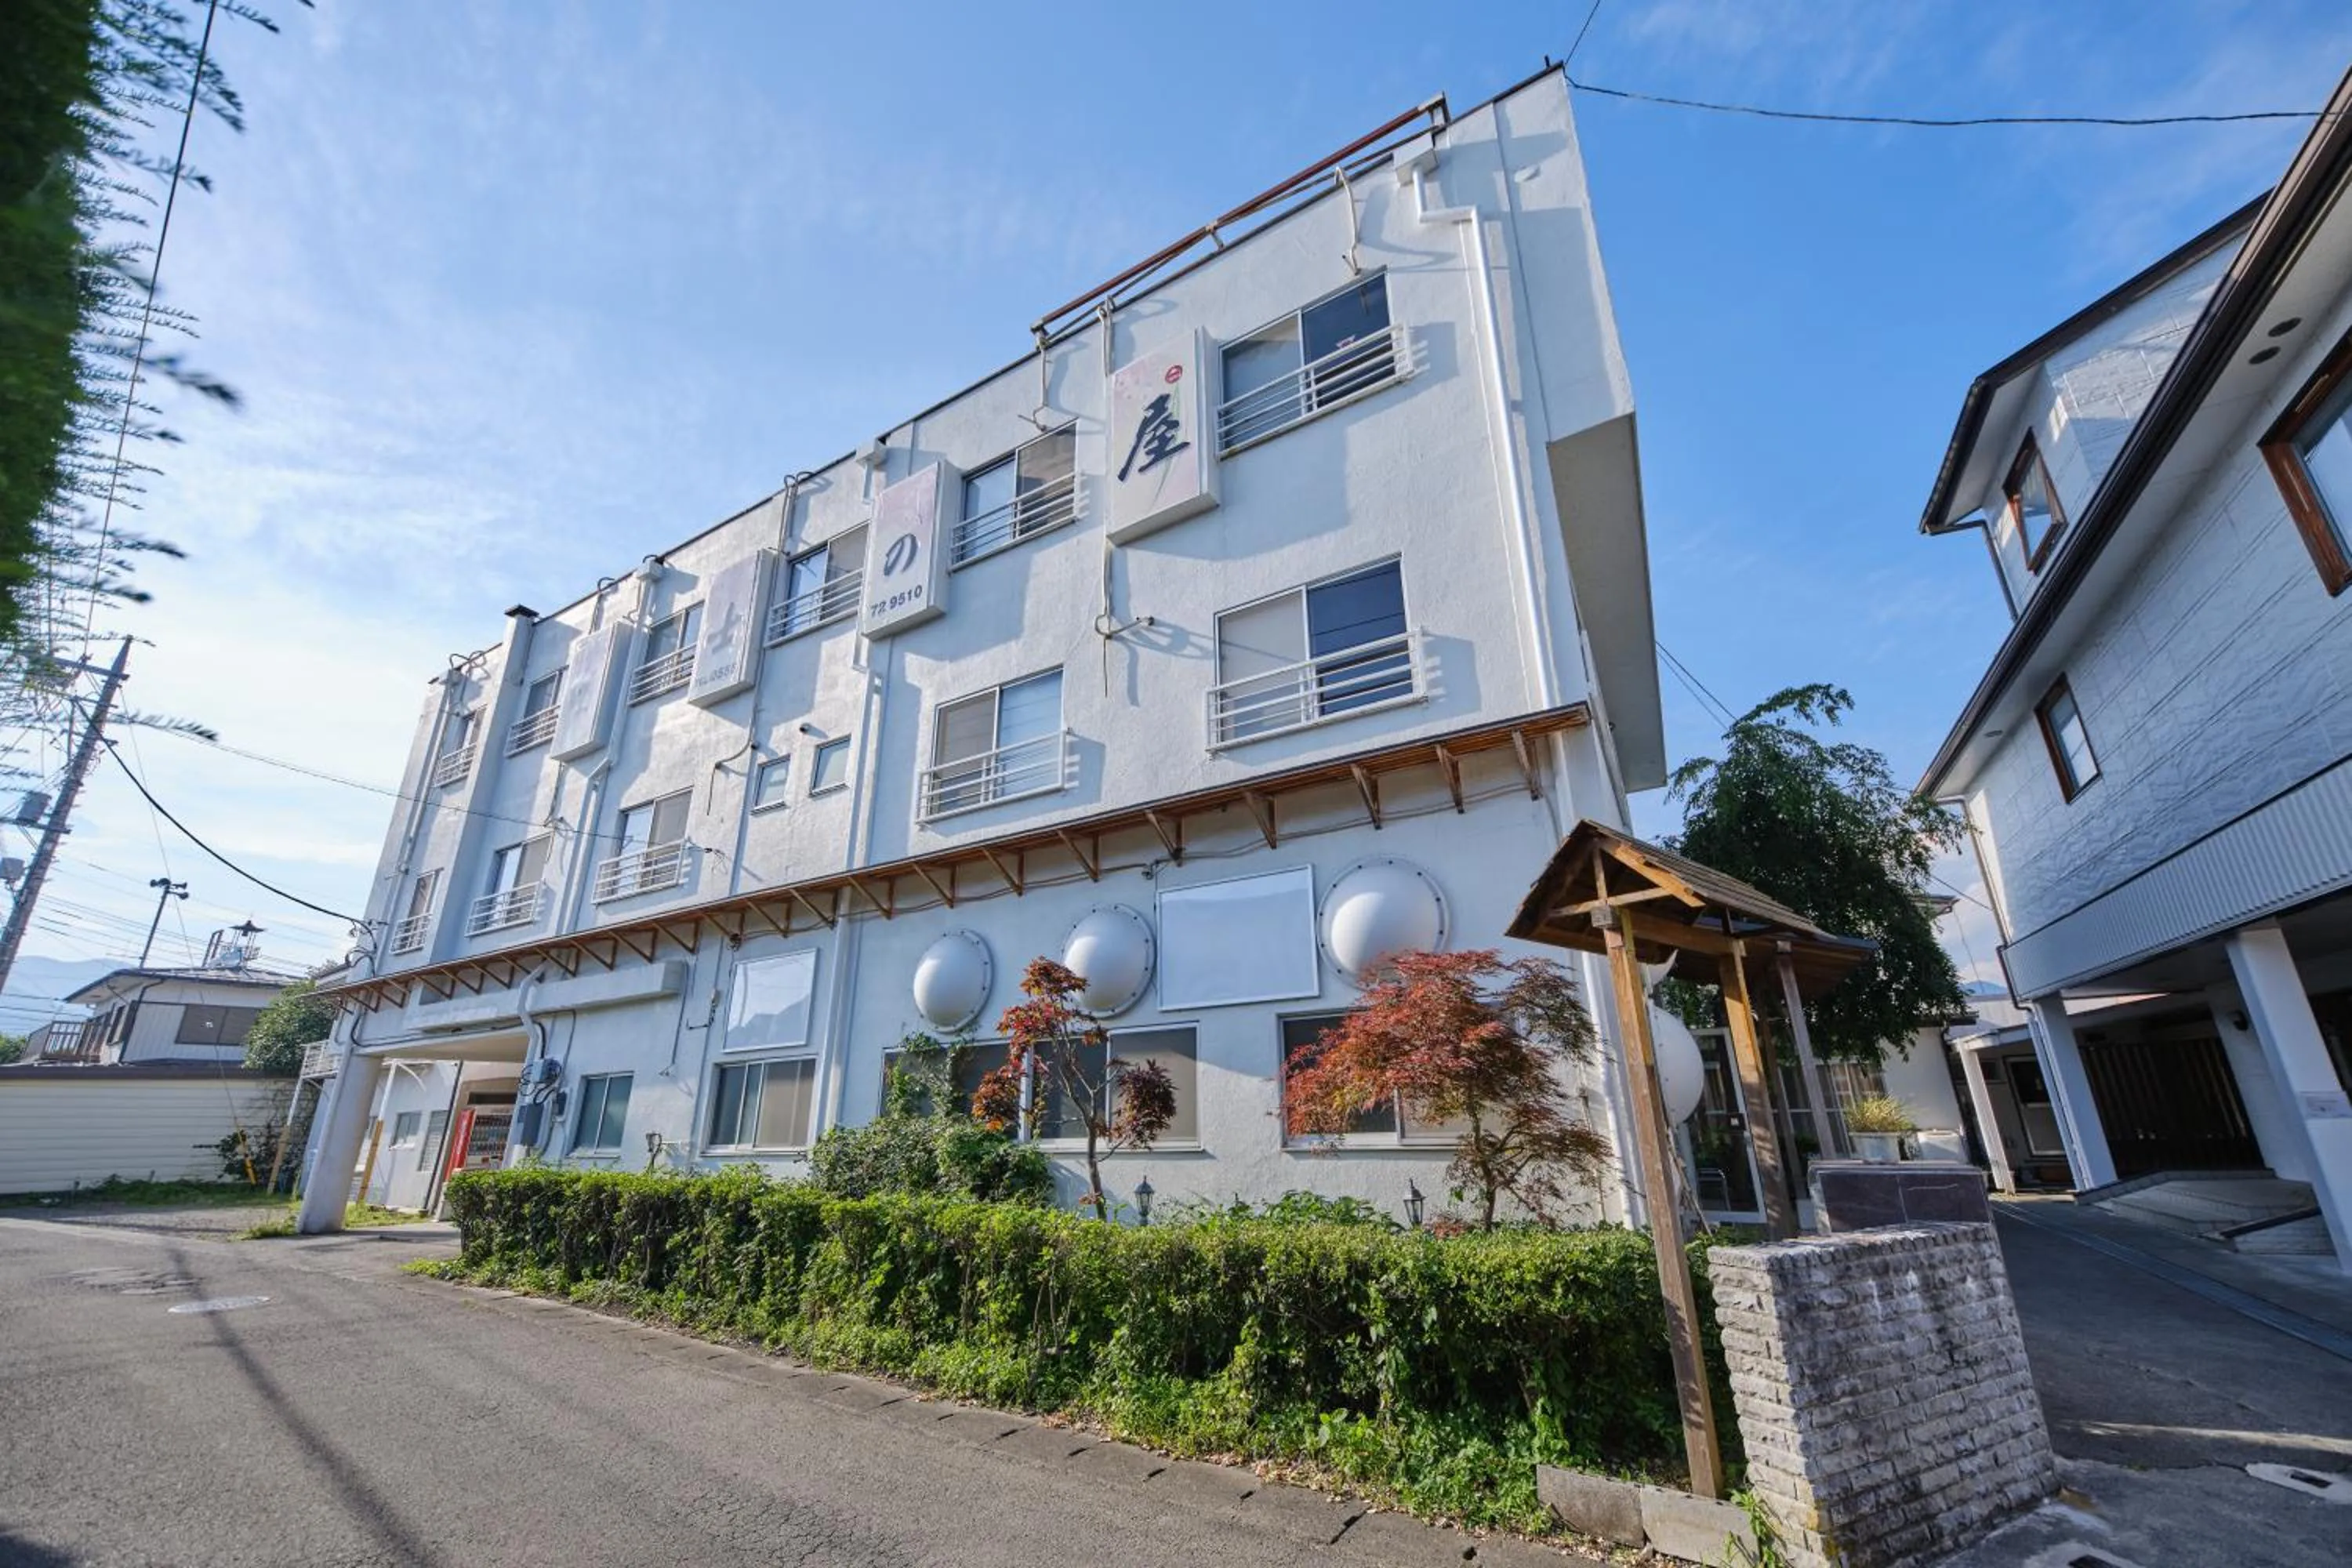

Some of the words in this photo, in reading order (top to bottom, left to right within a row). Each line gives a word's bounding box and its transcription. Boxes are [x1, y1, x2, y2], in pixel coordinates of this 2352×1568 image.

[1117, 394, 1191, 481] 屋
[884, 532, 920, 577] の
[870, 601, 886, 618] 72
[890, 584, 923, 610] 9510
